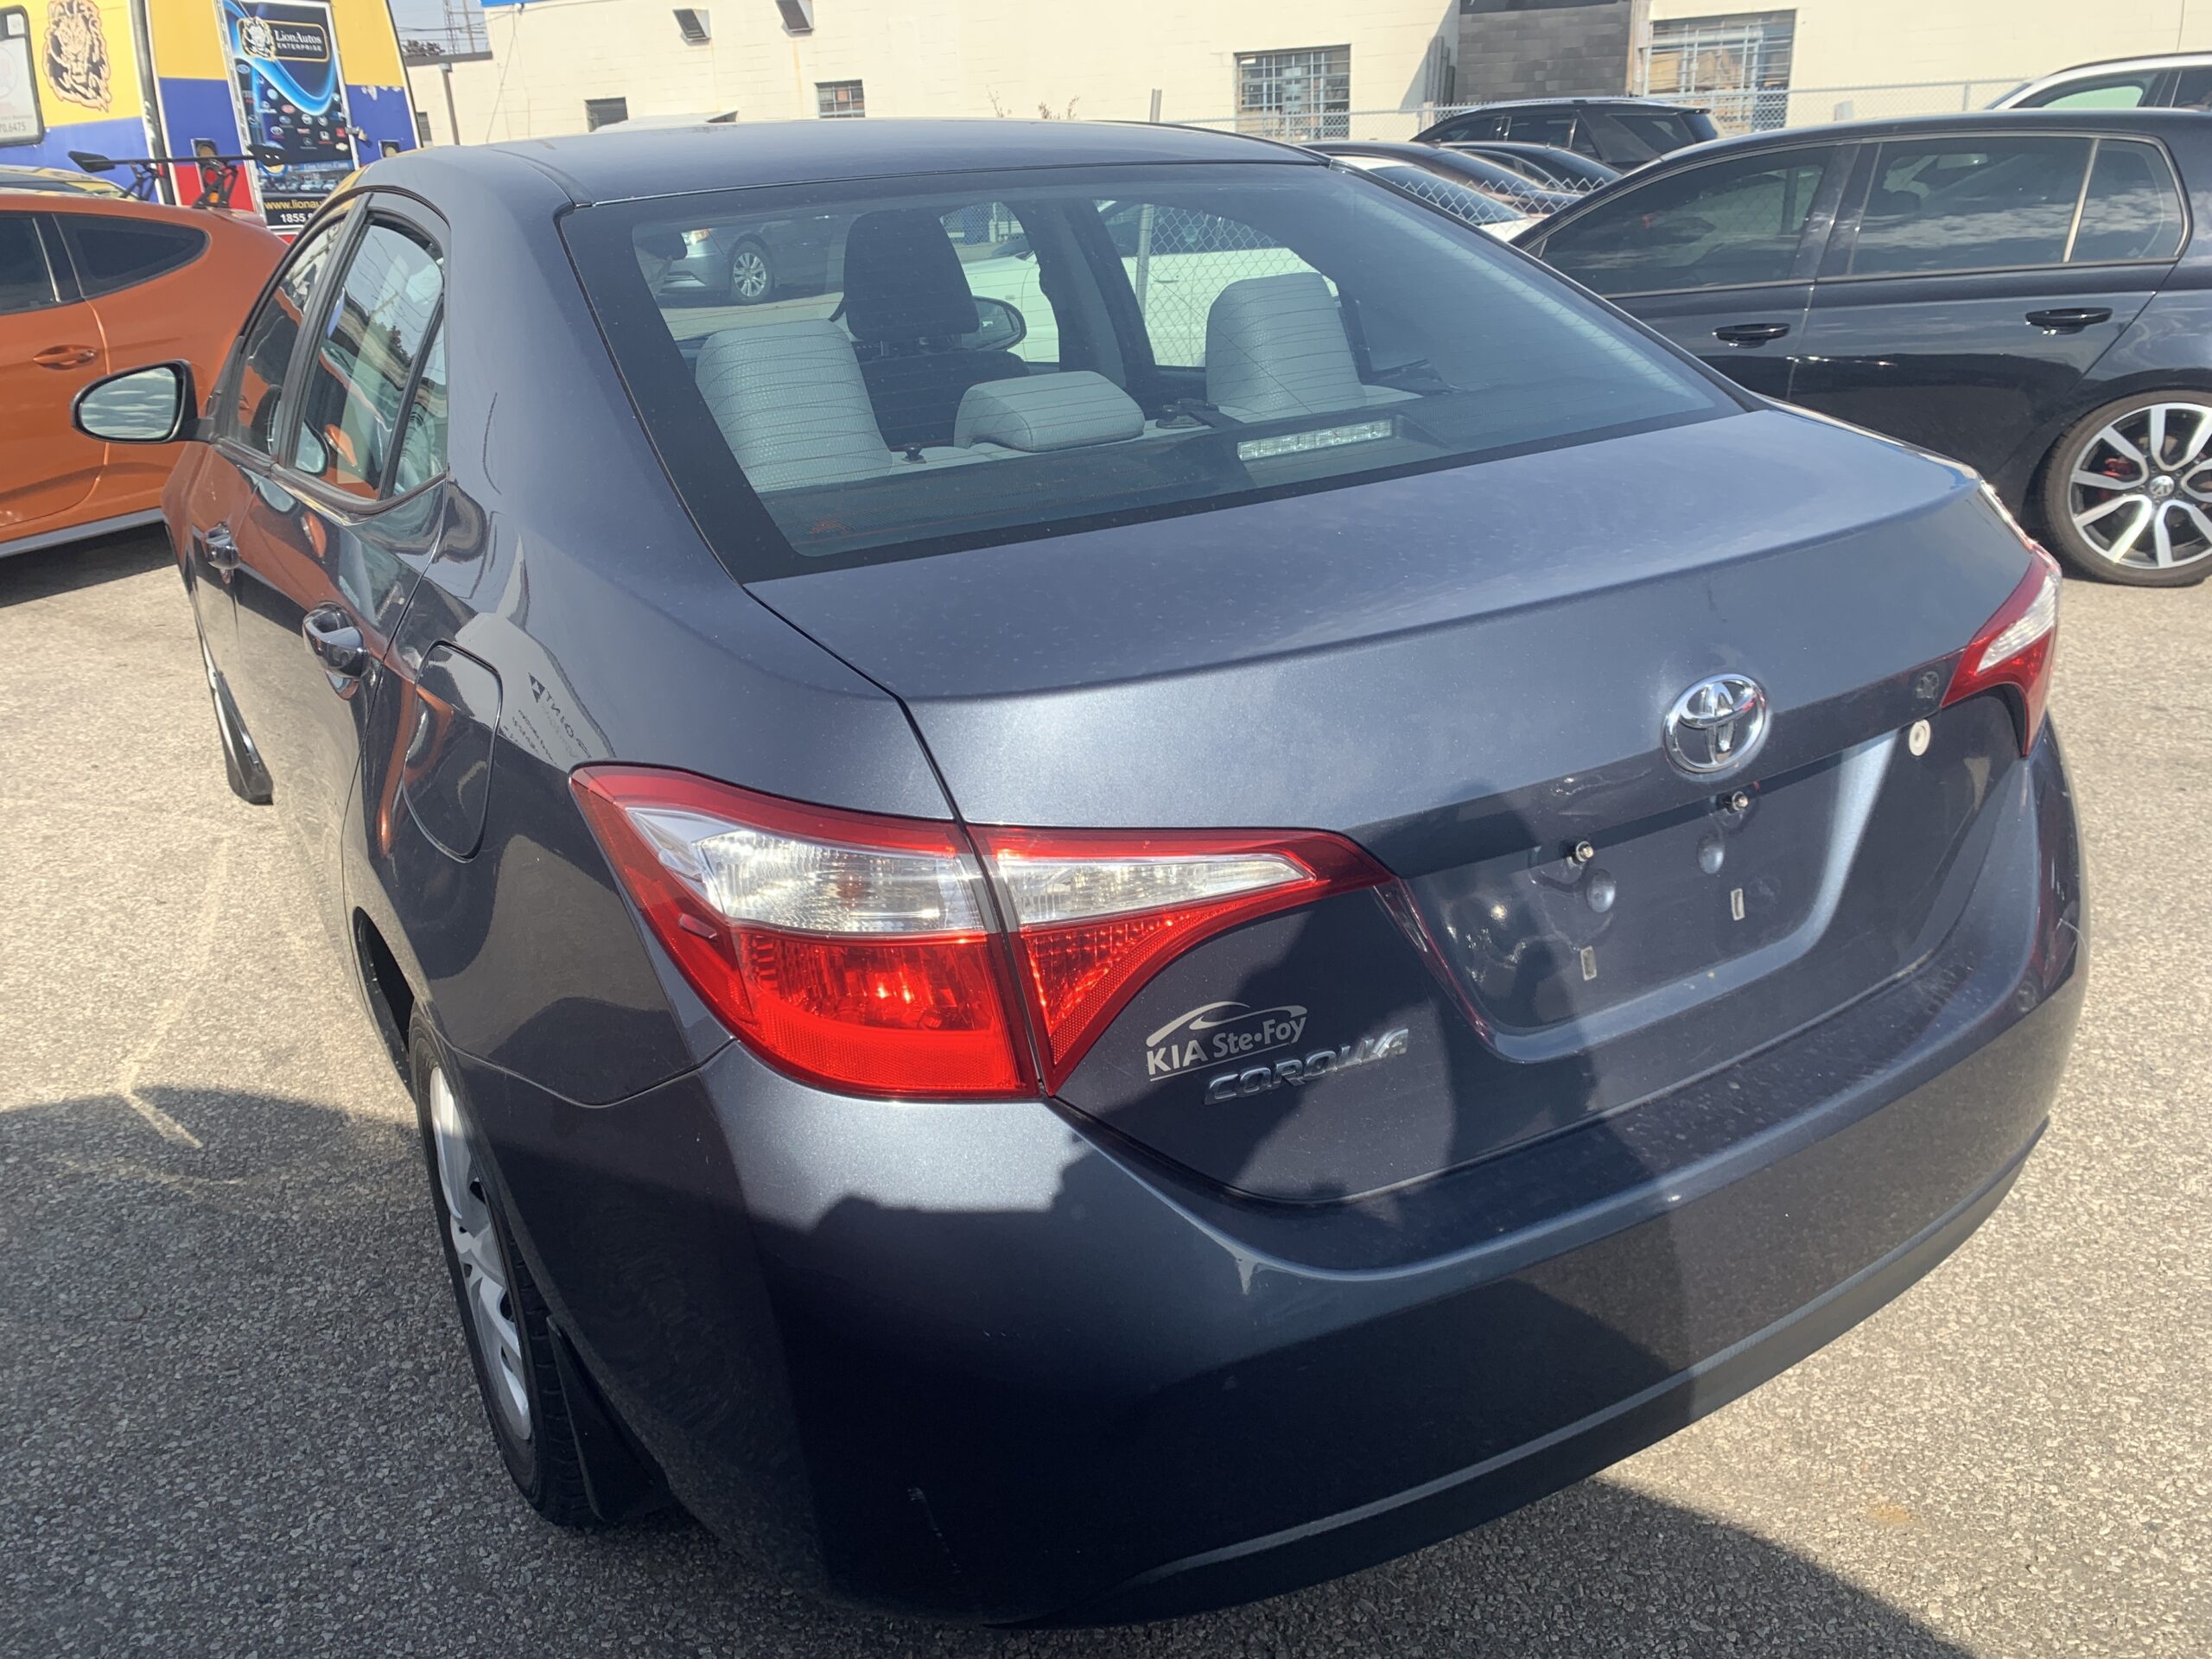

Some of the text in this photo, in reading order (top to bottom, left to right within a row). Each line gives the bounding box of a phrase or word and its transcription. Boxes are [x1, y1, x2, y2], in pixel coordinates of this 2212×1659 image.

[273, 29, 323, 44] LionAutos
[276, 42, 323, 52] ENTERPRISE
[280, 213, 306, 223] 1855
[1146, 1039, 1209, 1076] KIA
[1205, 1028, 1408, 1106] COROLLA
